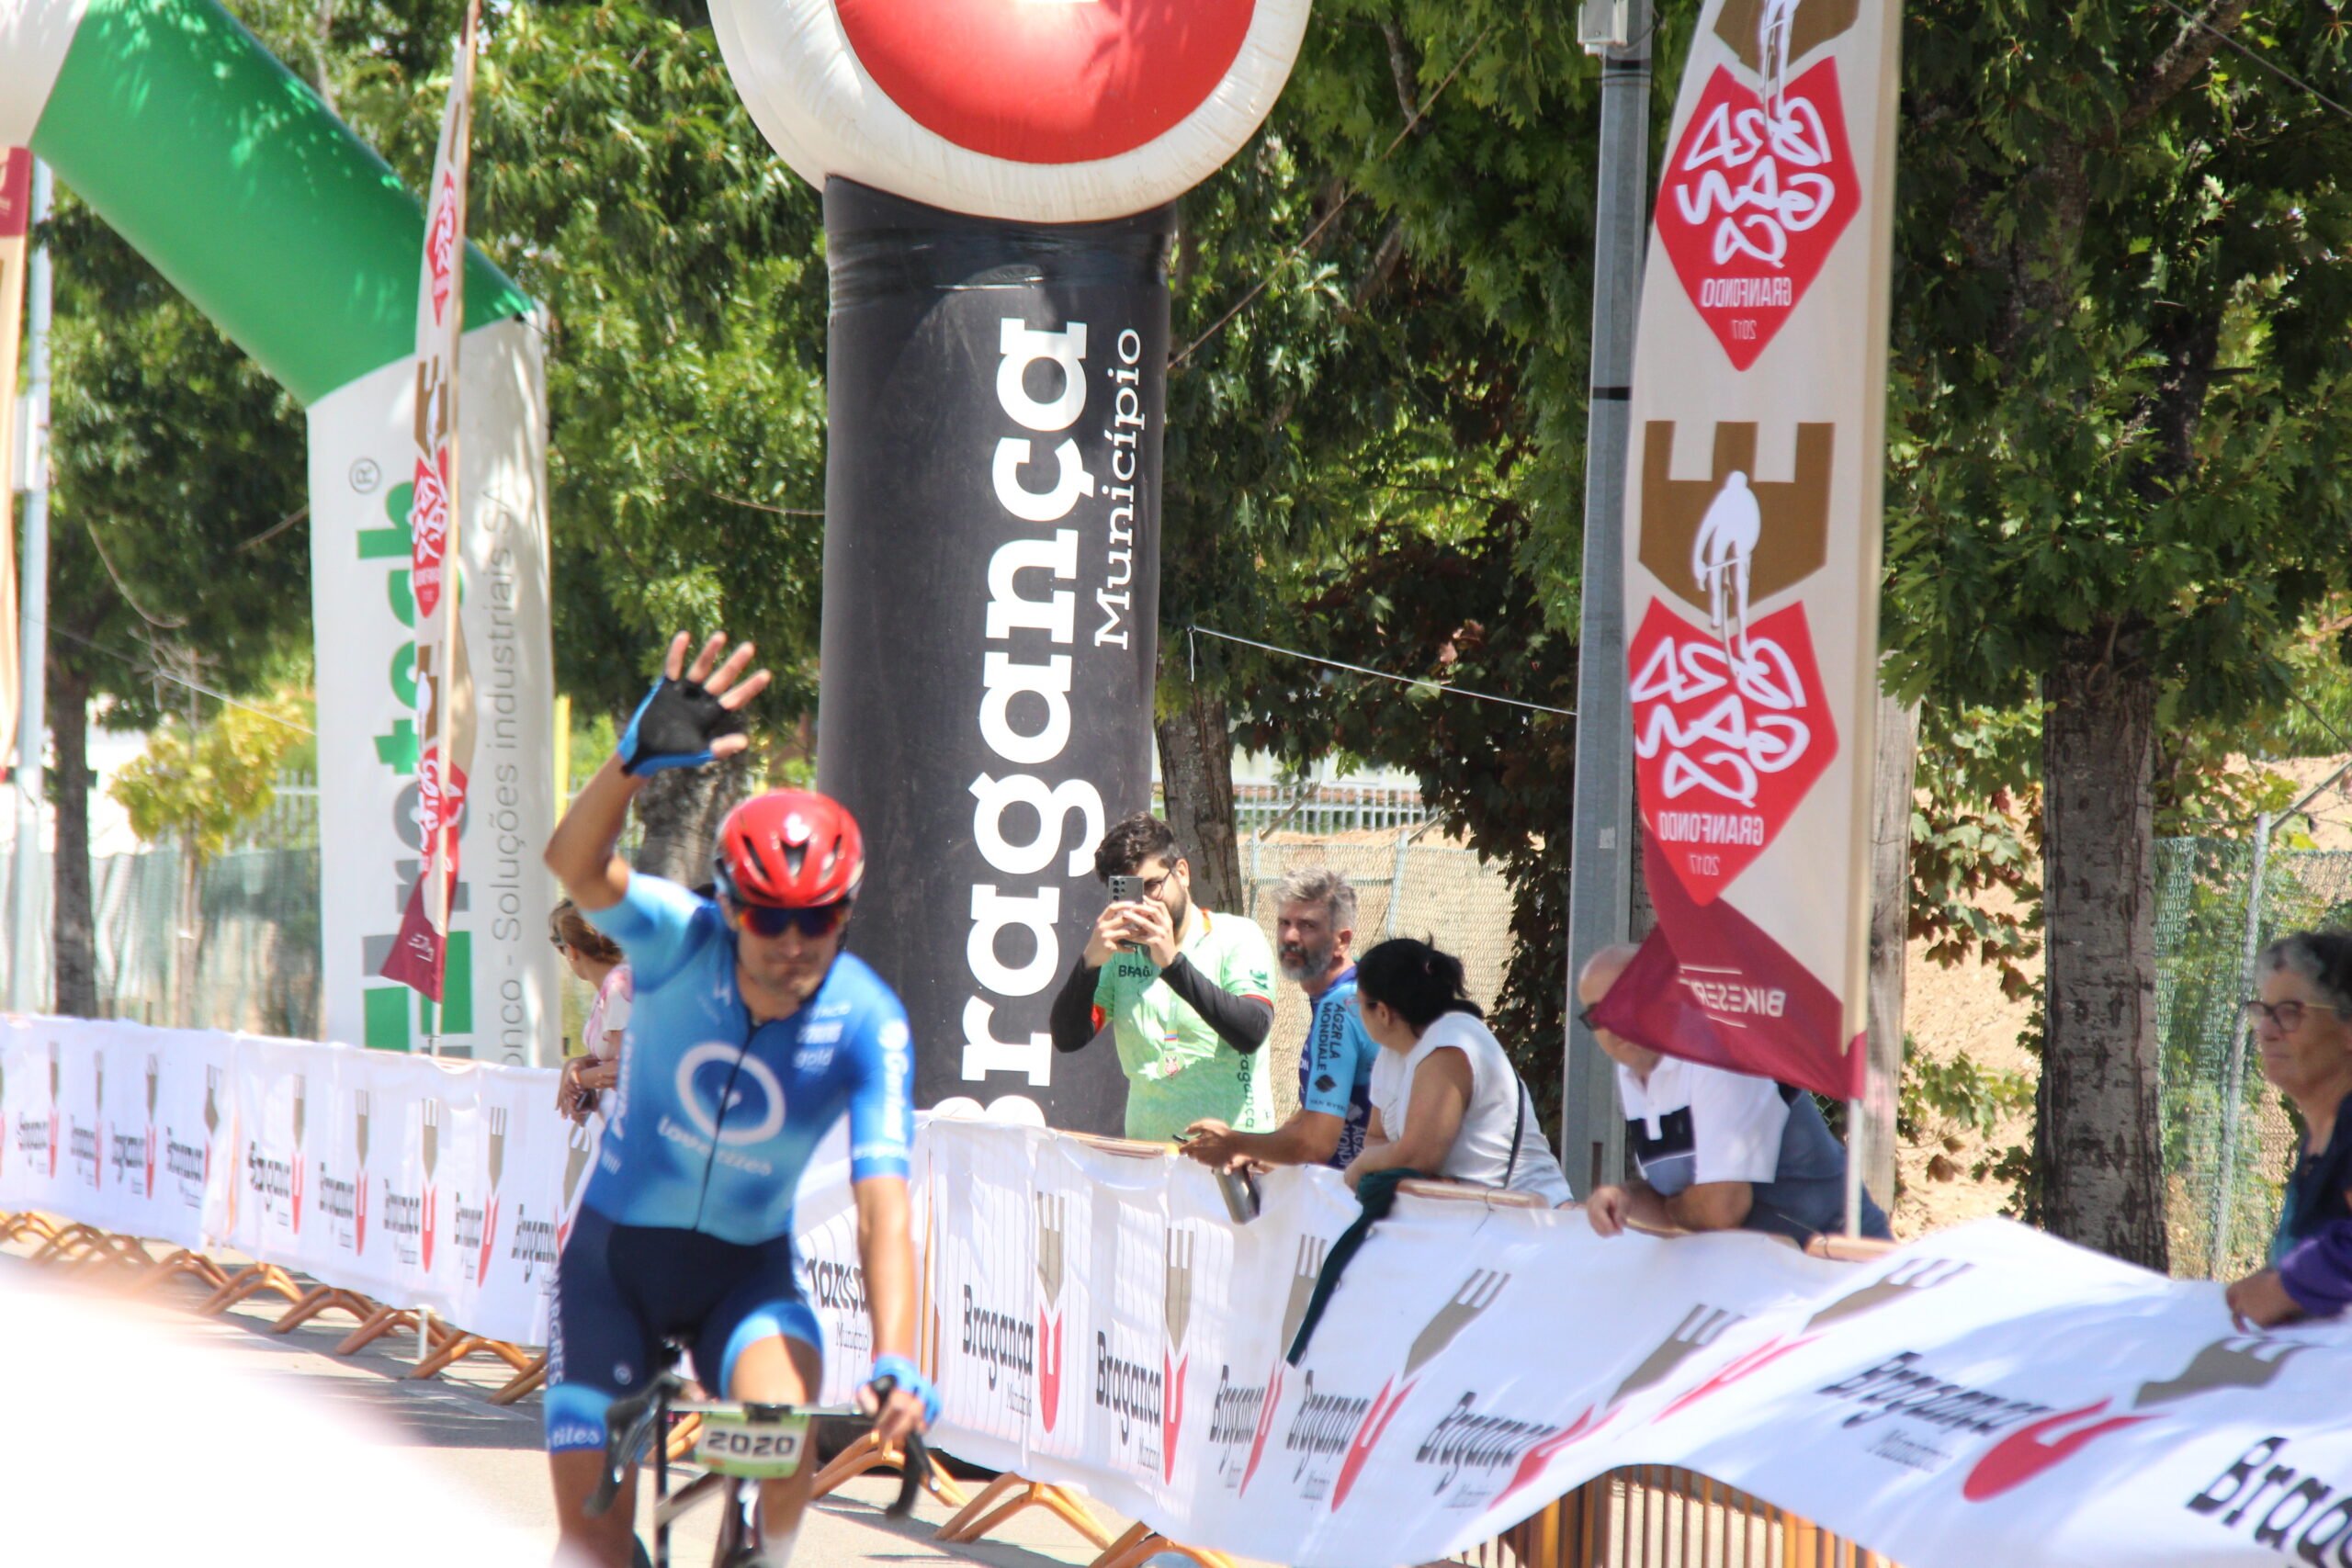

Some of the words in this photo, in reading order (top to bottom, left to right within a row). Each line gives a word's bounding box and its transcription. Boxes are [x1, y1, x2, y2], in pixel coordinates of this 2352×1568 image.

[1094, 328, 1145, 650] Município
[481, 559, 520, 751] industriais
[932, 318, 1105, 1126] ragança
[486, 763, 522, 942] Soluções
[1317, 1002, 1331, 1071] MONDIALE
[1329, 1043, 1340, 1059] LA
[962, 1283, 1034, 1392] Bragança
[1095, 1329, 1161, 1447] Bragança
[707, 1430, 796, 1458] 2020
